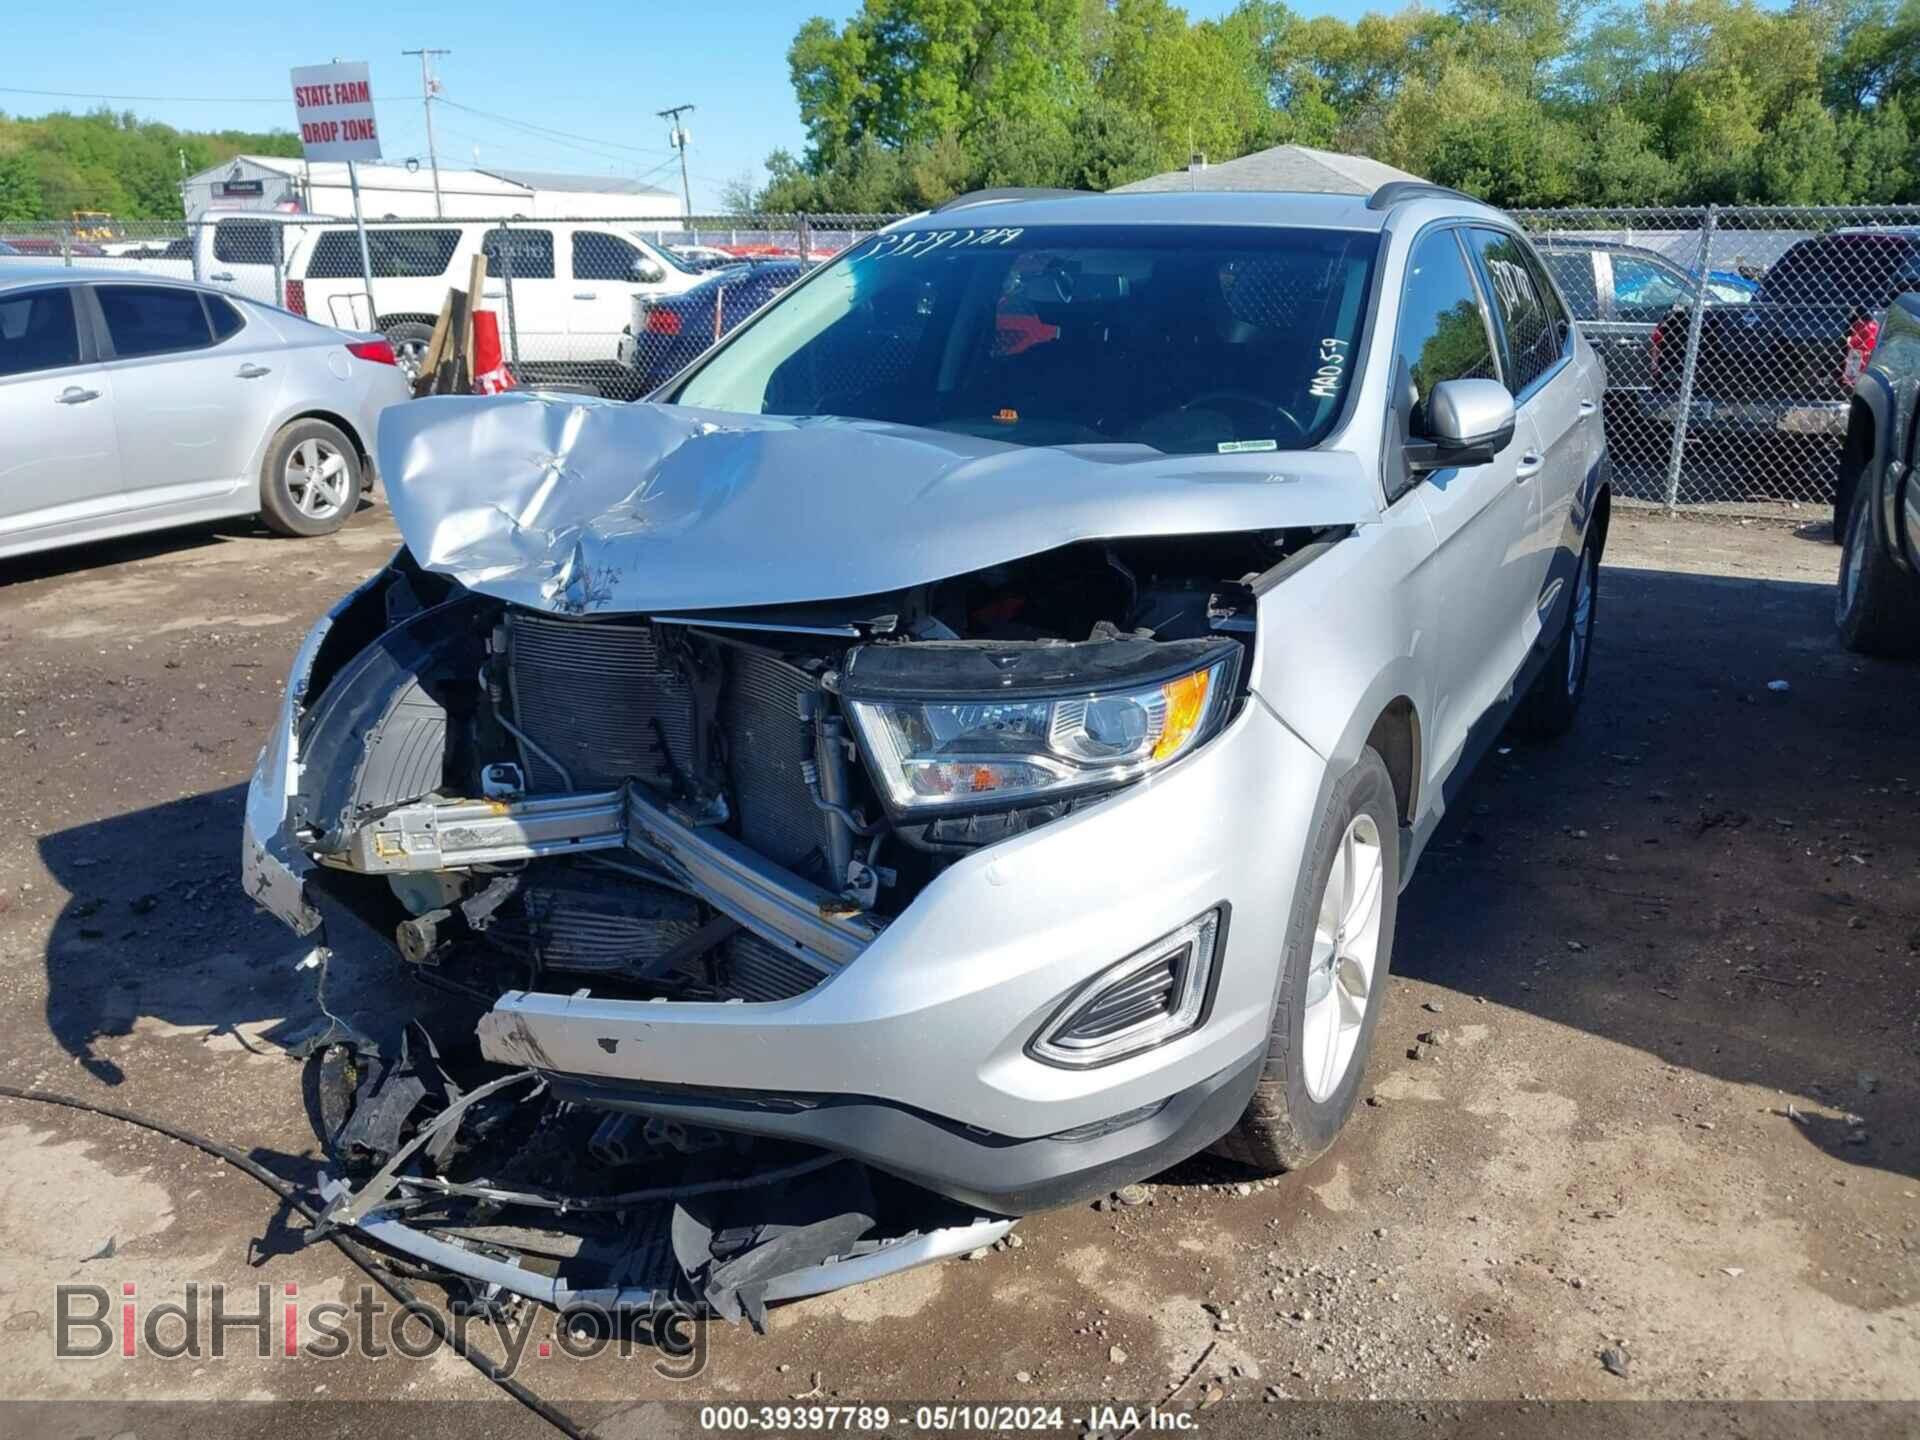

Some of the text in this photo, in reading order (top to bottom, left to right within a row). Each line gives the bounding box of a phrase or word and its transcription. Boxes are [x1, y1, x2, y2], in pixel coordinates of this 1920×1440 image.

[295, 80, 370, 108] STATE FARM
[302, 118, 377, 144] DROP ZONE
